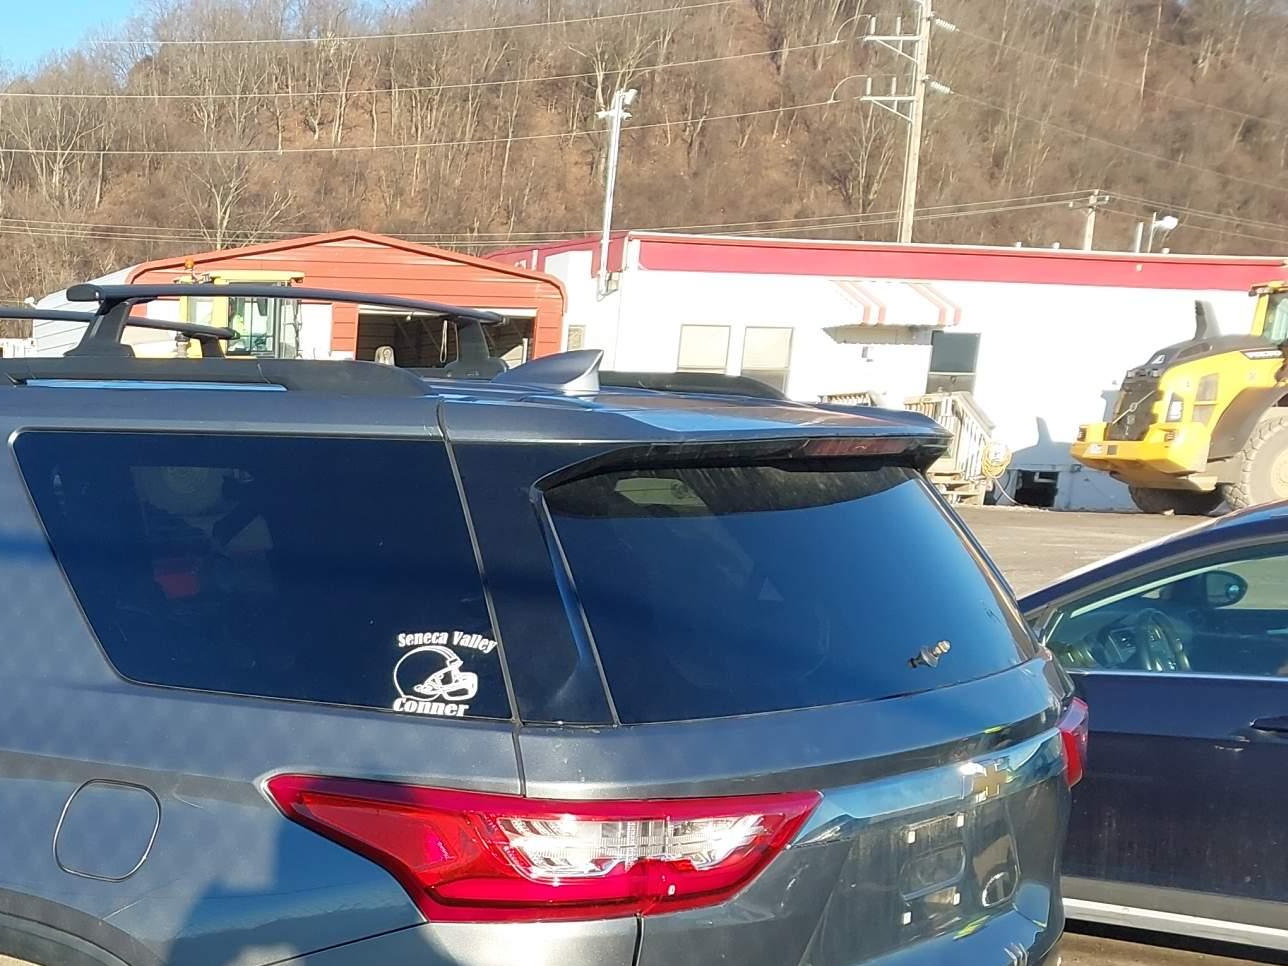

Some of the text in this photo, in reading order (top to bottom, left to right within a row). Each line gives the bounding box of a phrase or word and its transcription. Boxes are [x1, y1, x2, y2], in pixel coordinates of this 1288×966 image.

[399, 631, 498, 654] Seneca Valley
[393, 697, 470, 717] Conner
